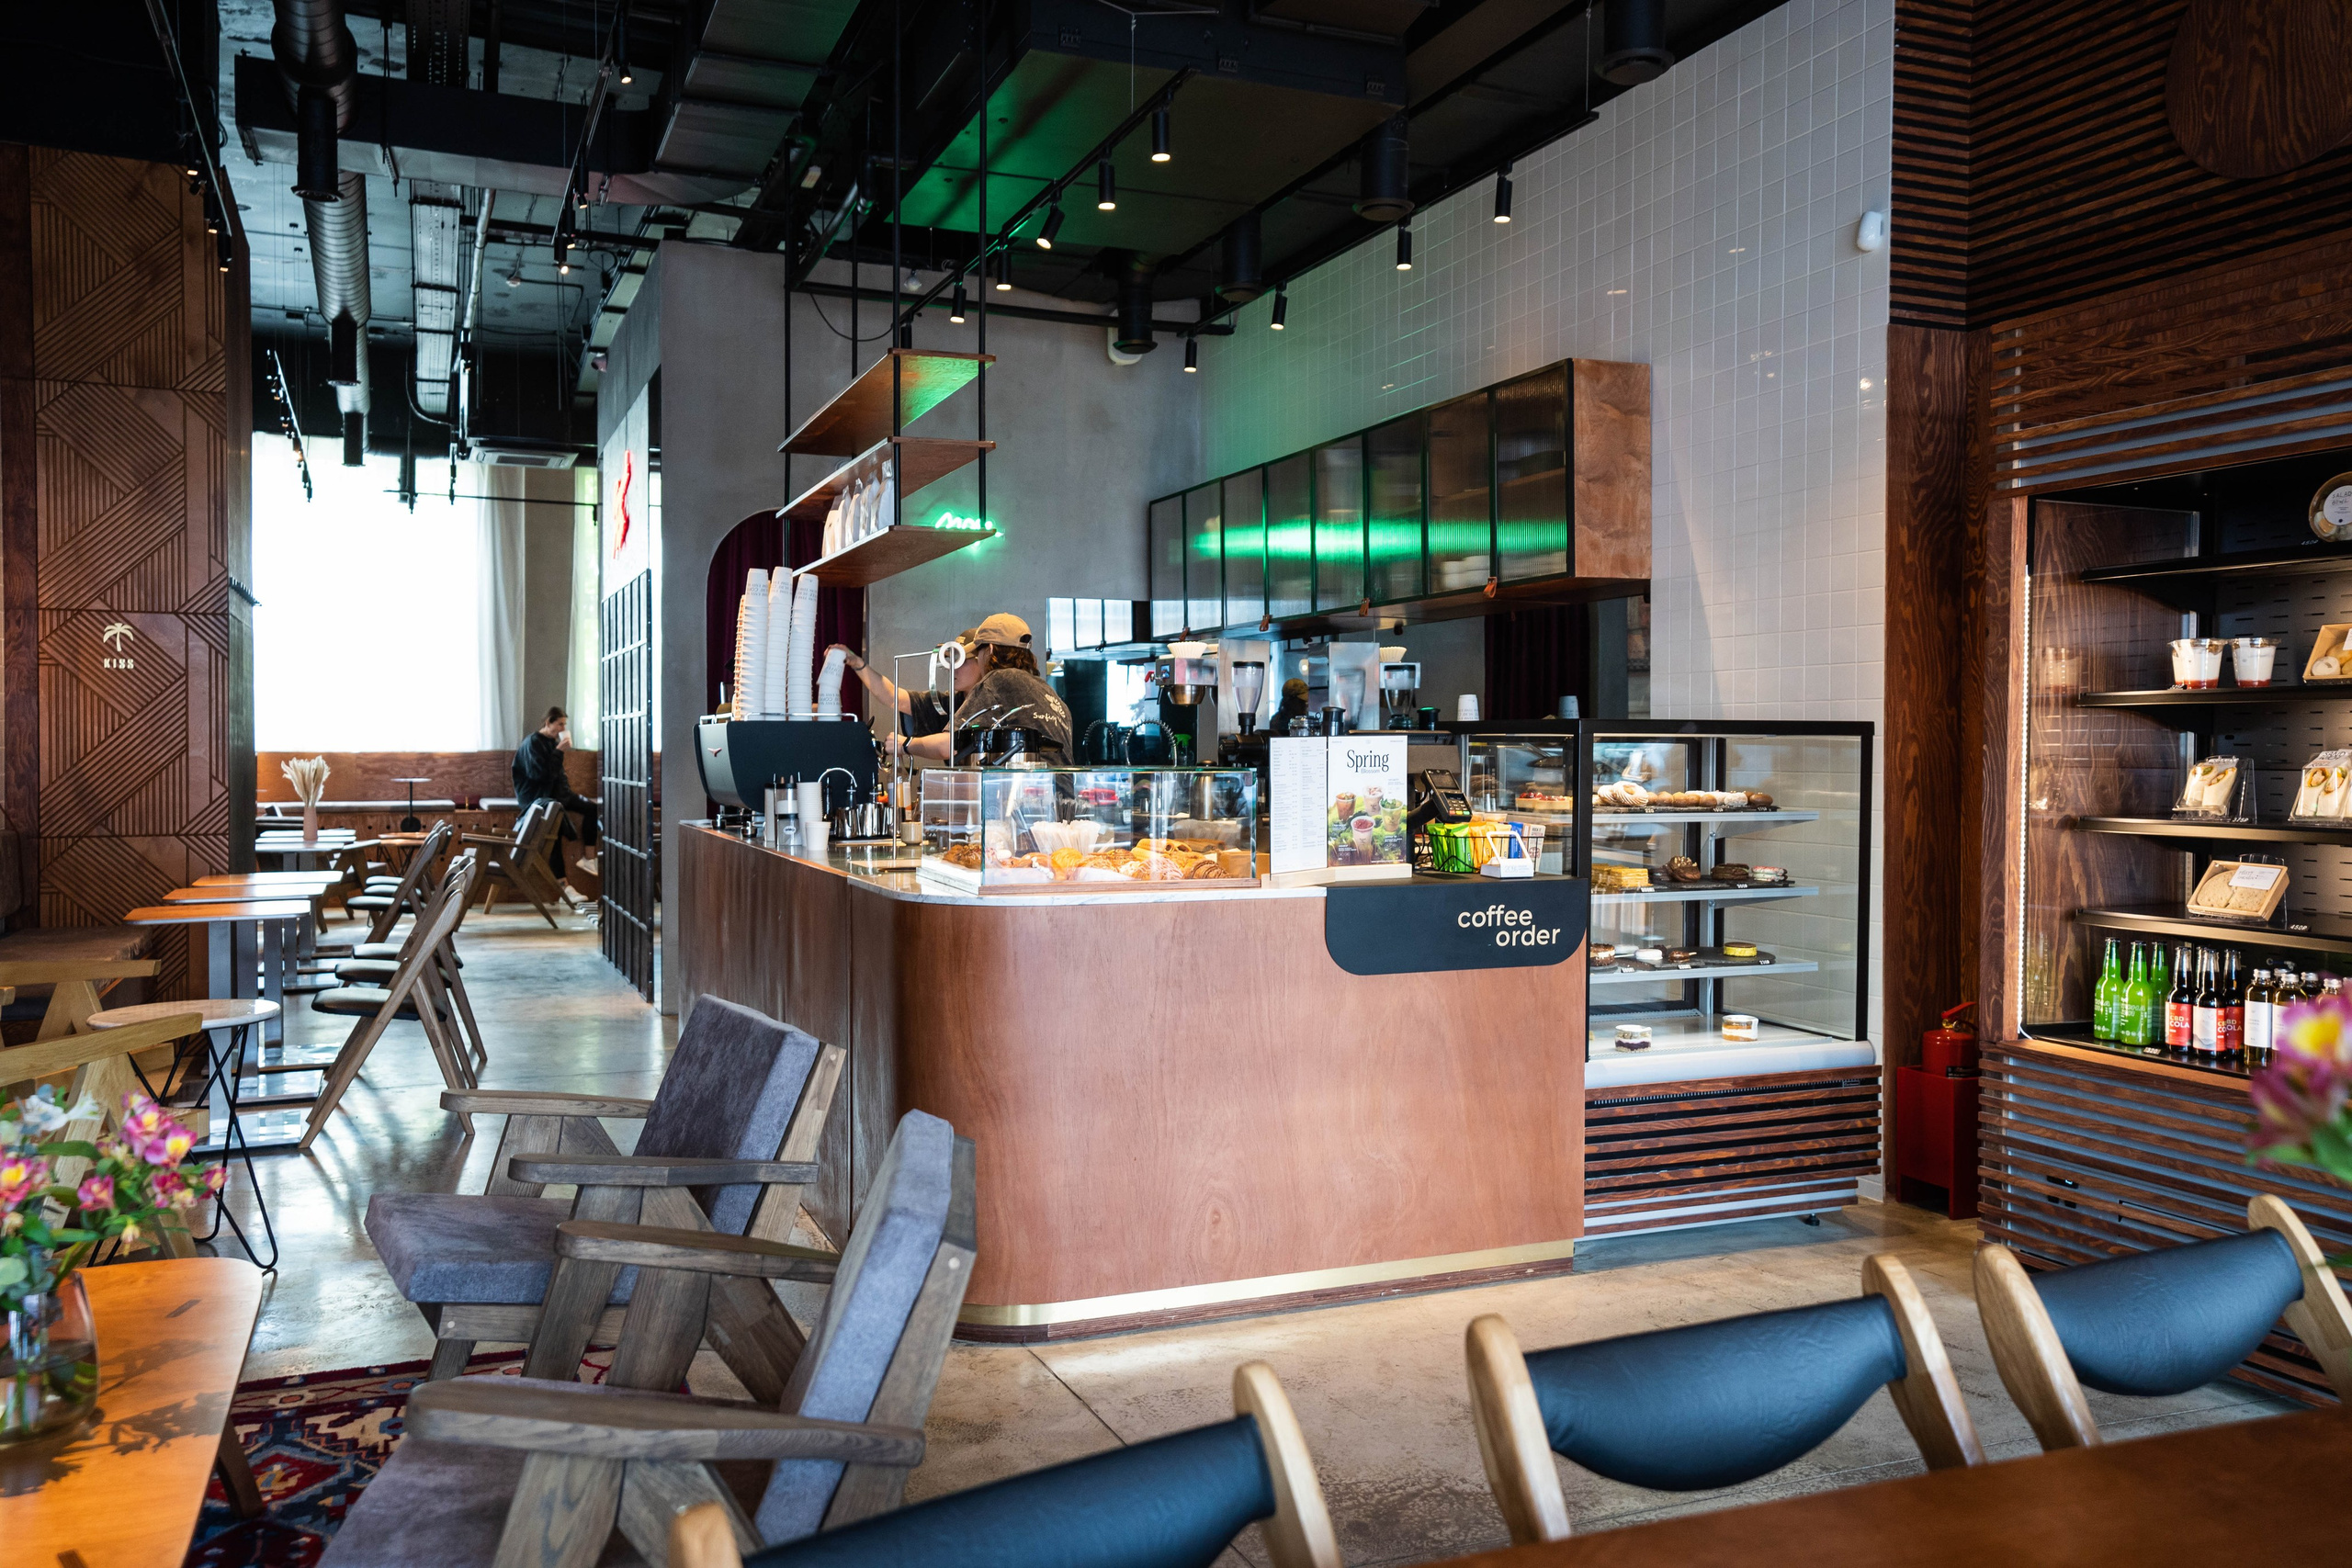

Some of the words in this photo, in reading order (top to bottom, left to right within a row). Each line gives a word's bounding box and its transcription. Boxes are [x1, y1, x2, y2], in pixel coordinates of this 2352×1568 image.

[104, 658, 134, 669] KISS
[1346, 749, 1390, 773] Spring
[1457, 904, 1532, 928] coffee
[1495, 924, 1560, 946] order
[2169, 1021, 2190, 1029] COLA
